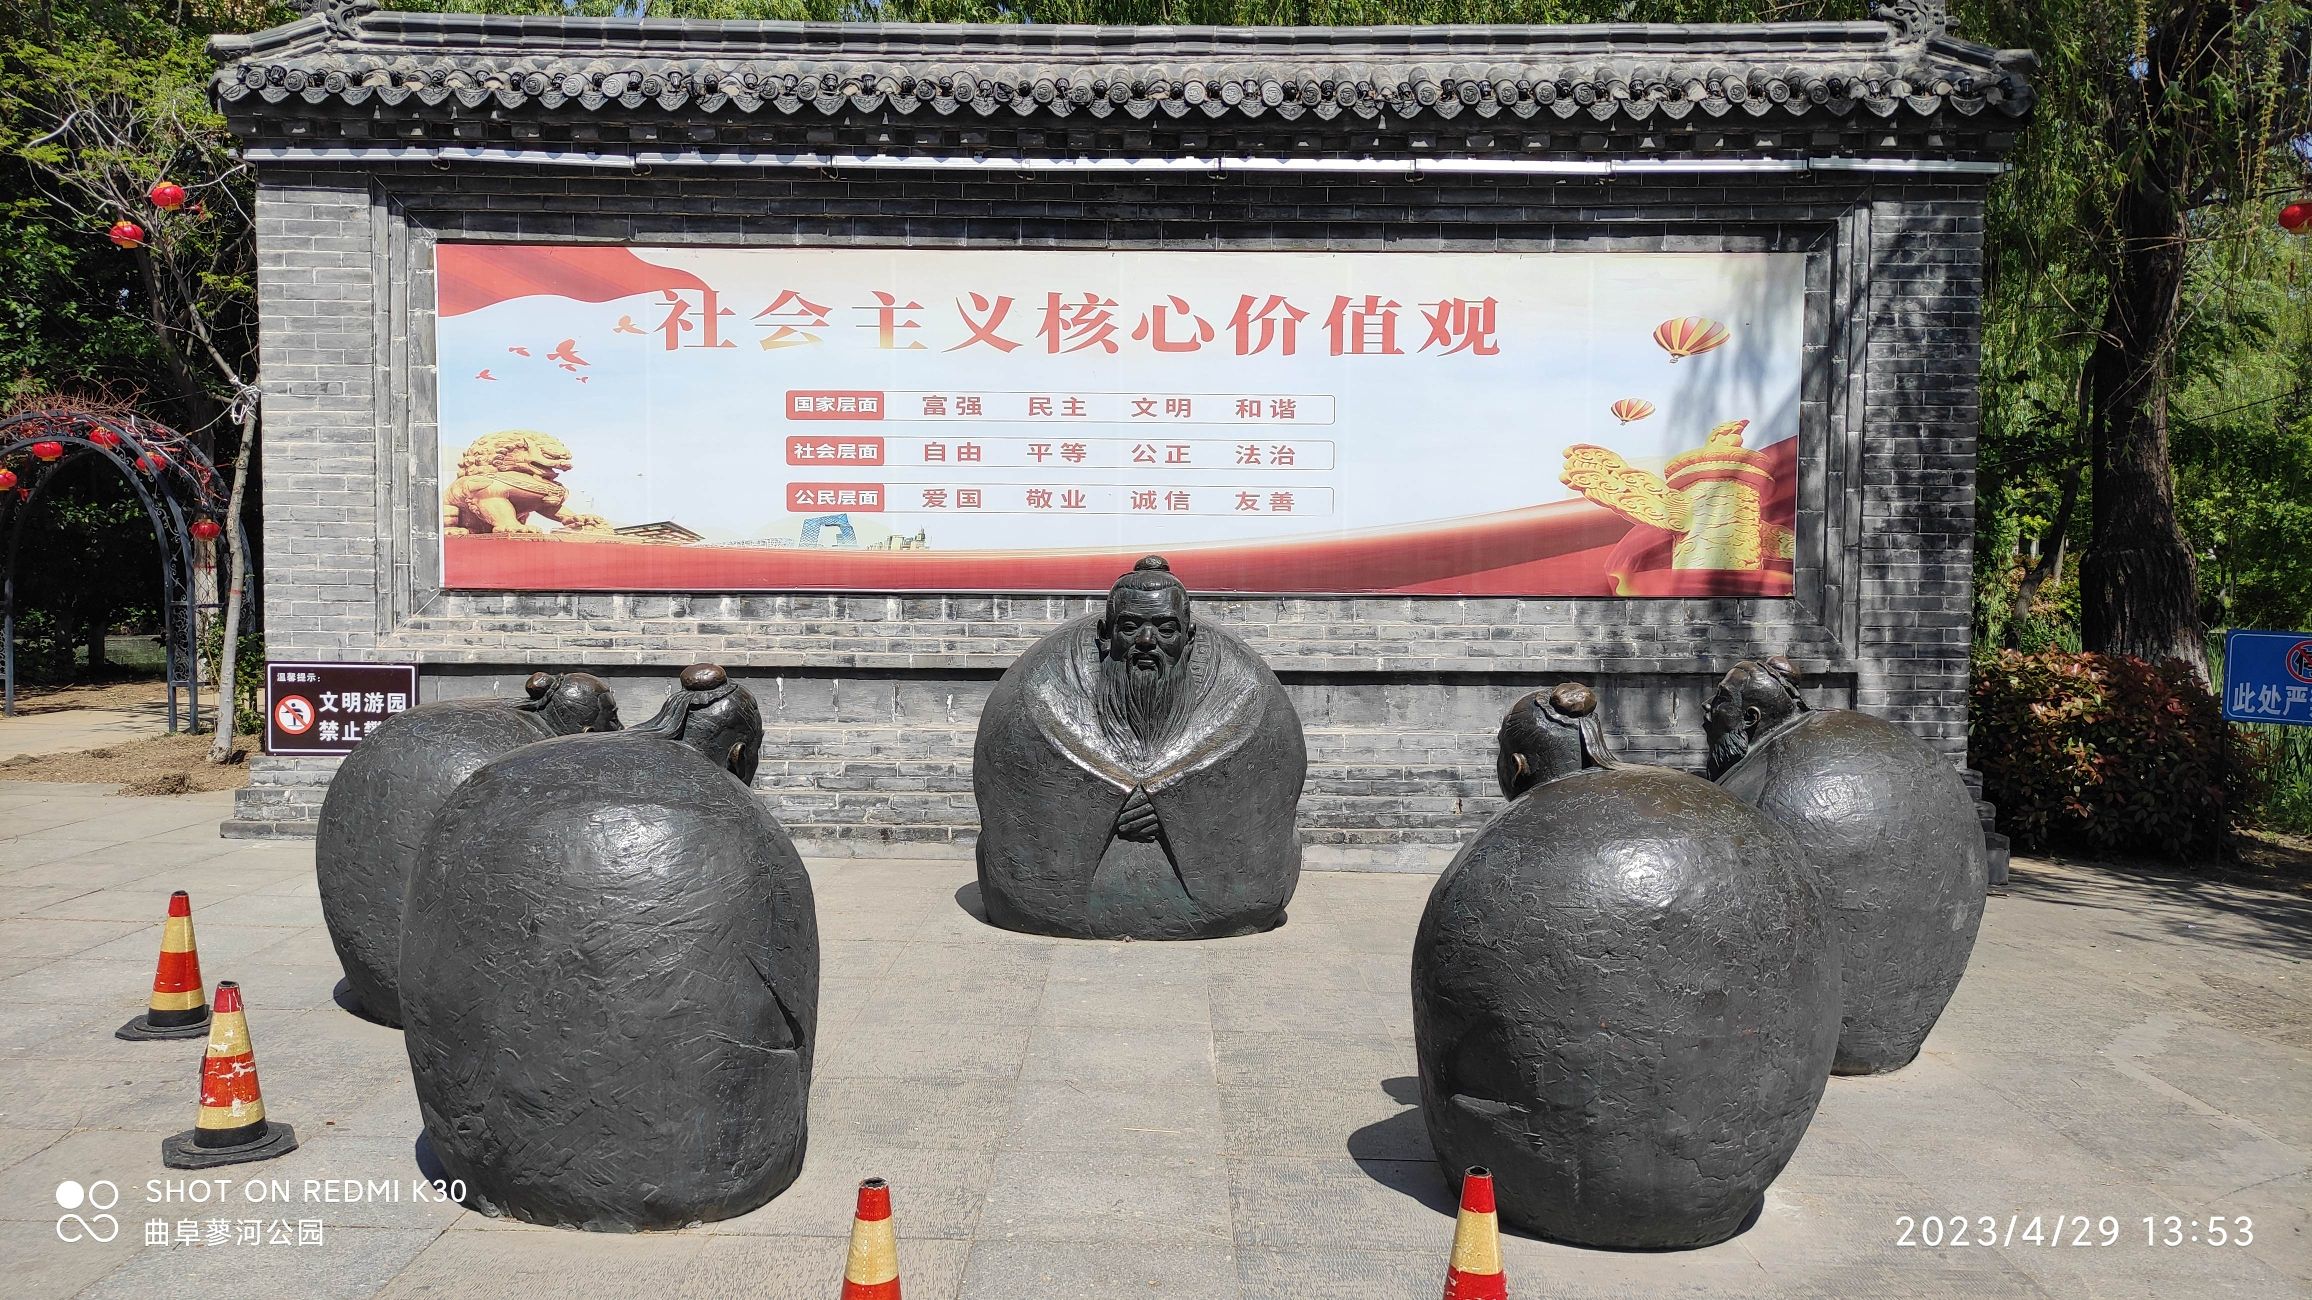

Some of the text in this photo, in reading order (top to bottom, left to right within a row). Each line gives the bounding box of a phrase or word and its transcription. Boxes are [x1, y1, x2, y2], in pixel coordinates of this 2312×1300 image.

[653, 289, 1501, 357] 社会主义核心价值观
[794, 396, 878, 413] 国家层面
[923, 395, 1297, 419] 富强 民主 文明 和谐
[794, 442, 878, 459] 社会层面
[924, 441, 1296, 465] 自由 平等 公正 法治
[795, 488, 878, 506] 公民层面
[922, 488, 1295, 511] 爱国 敬业 诚信 友善
[319, 691, 406, 713] 文明游园
[2232, 682, 2312, 717] 此处严
